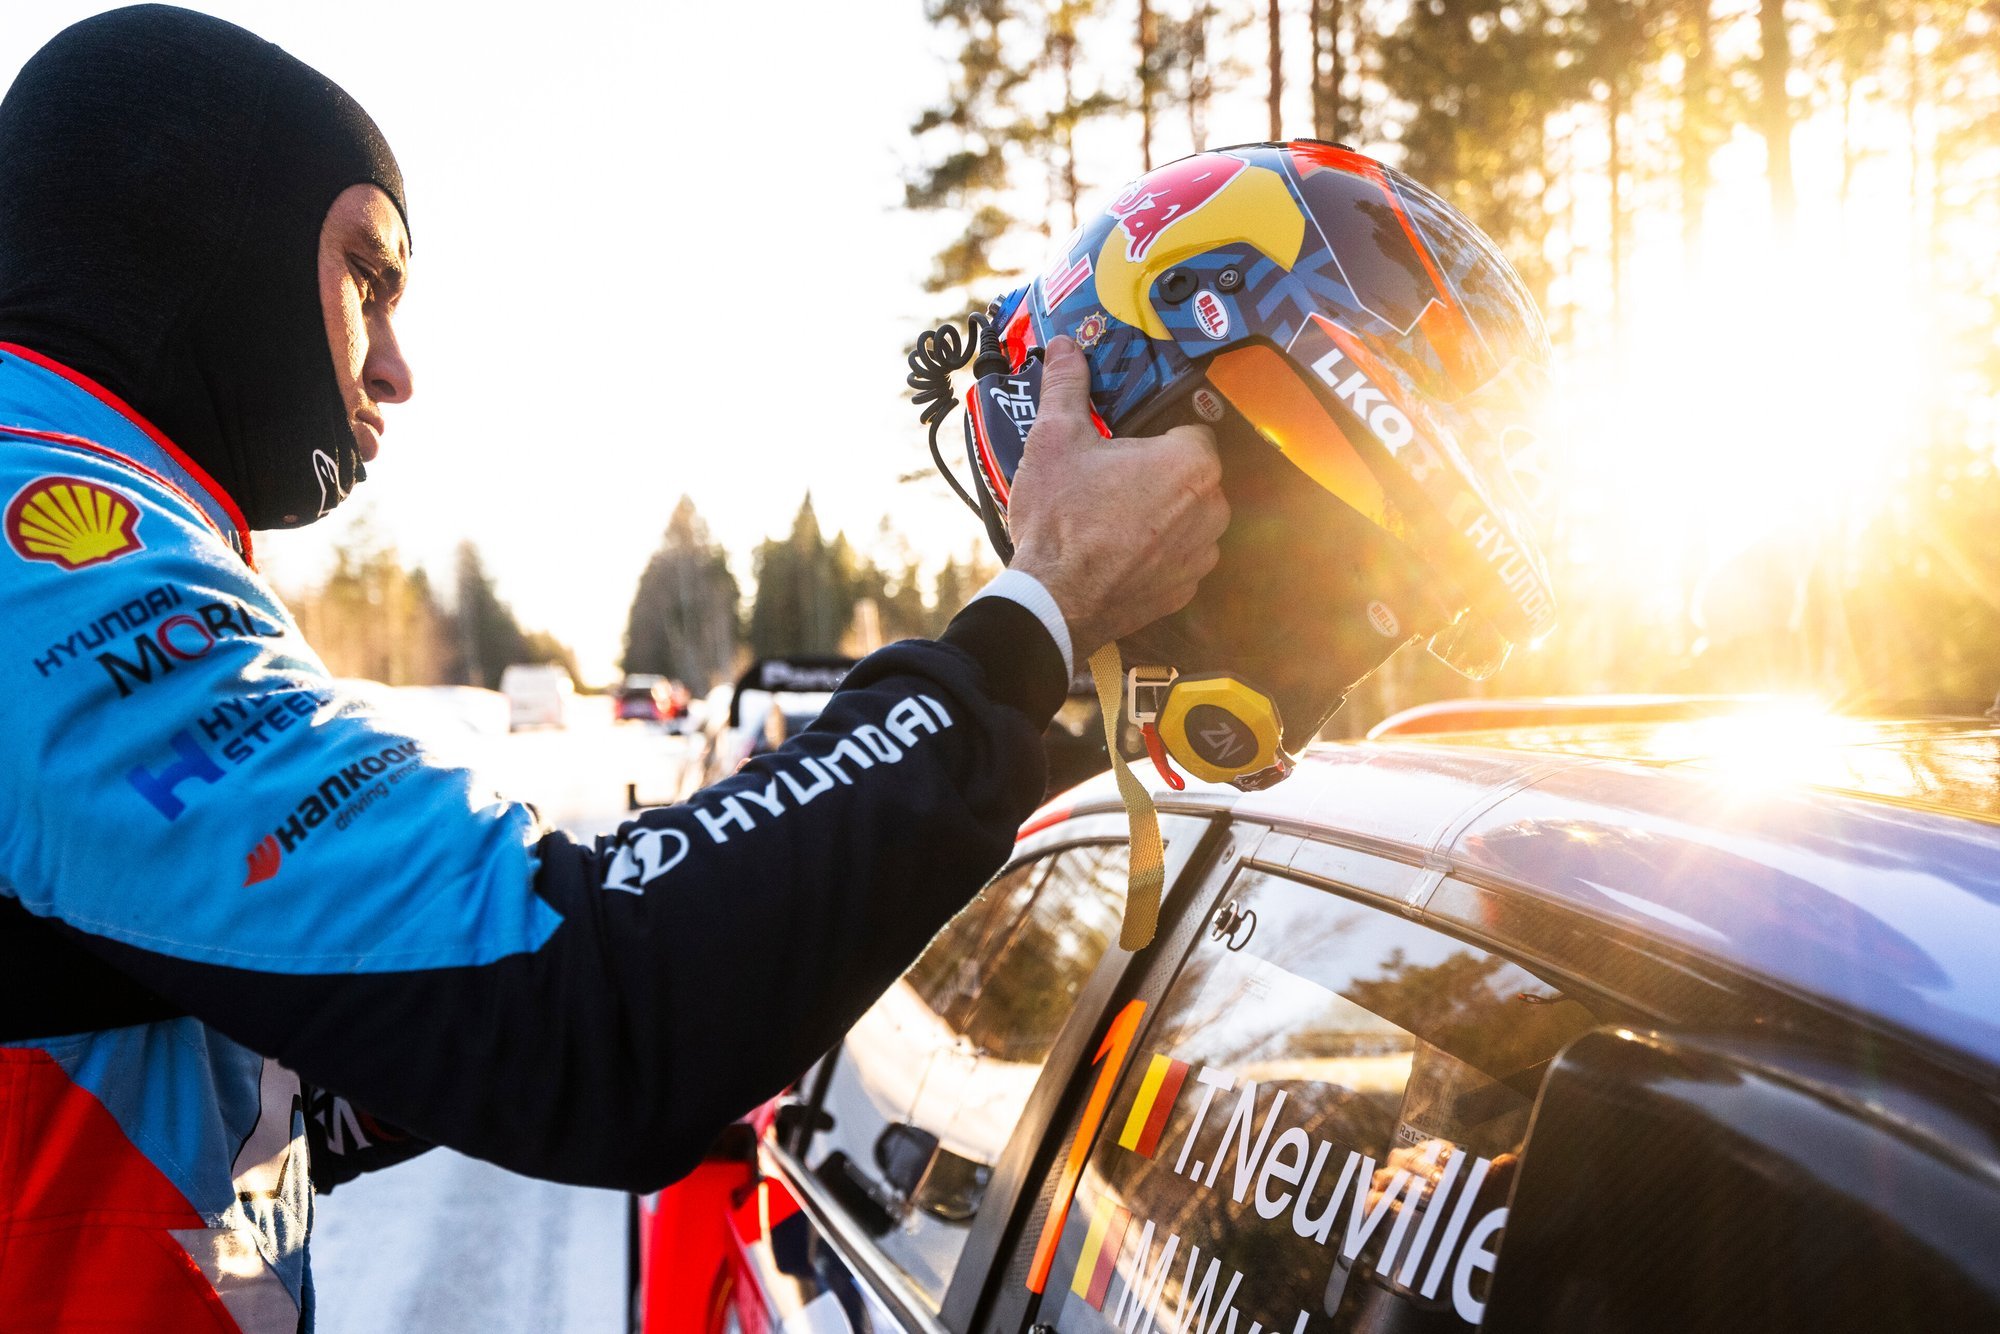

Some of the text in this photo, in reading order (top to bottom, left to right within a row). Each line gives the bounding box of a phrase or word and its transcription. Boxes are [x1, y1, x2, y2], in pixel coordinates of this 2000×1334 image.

[1198, 294, 1225, 334] BELL
[1196, 391, 1220, 418] BELL
[1311, 347, 1414, 459] LKQ
[33, 583, 182, 677] HYUNDAI
[693, 694, 954, 844] HYUNDAI
[1174, 1065, 1510, 1325] T.Neuville
